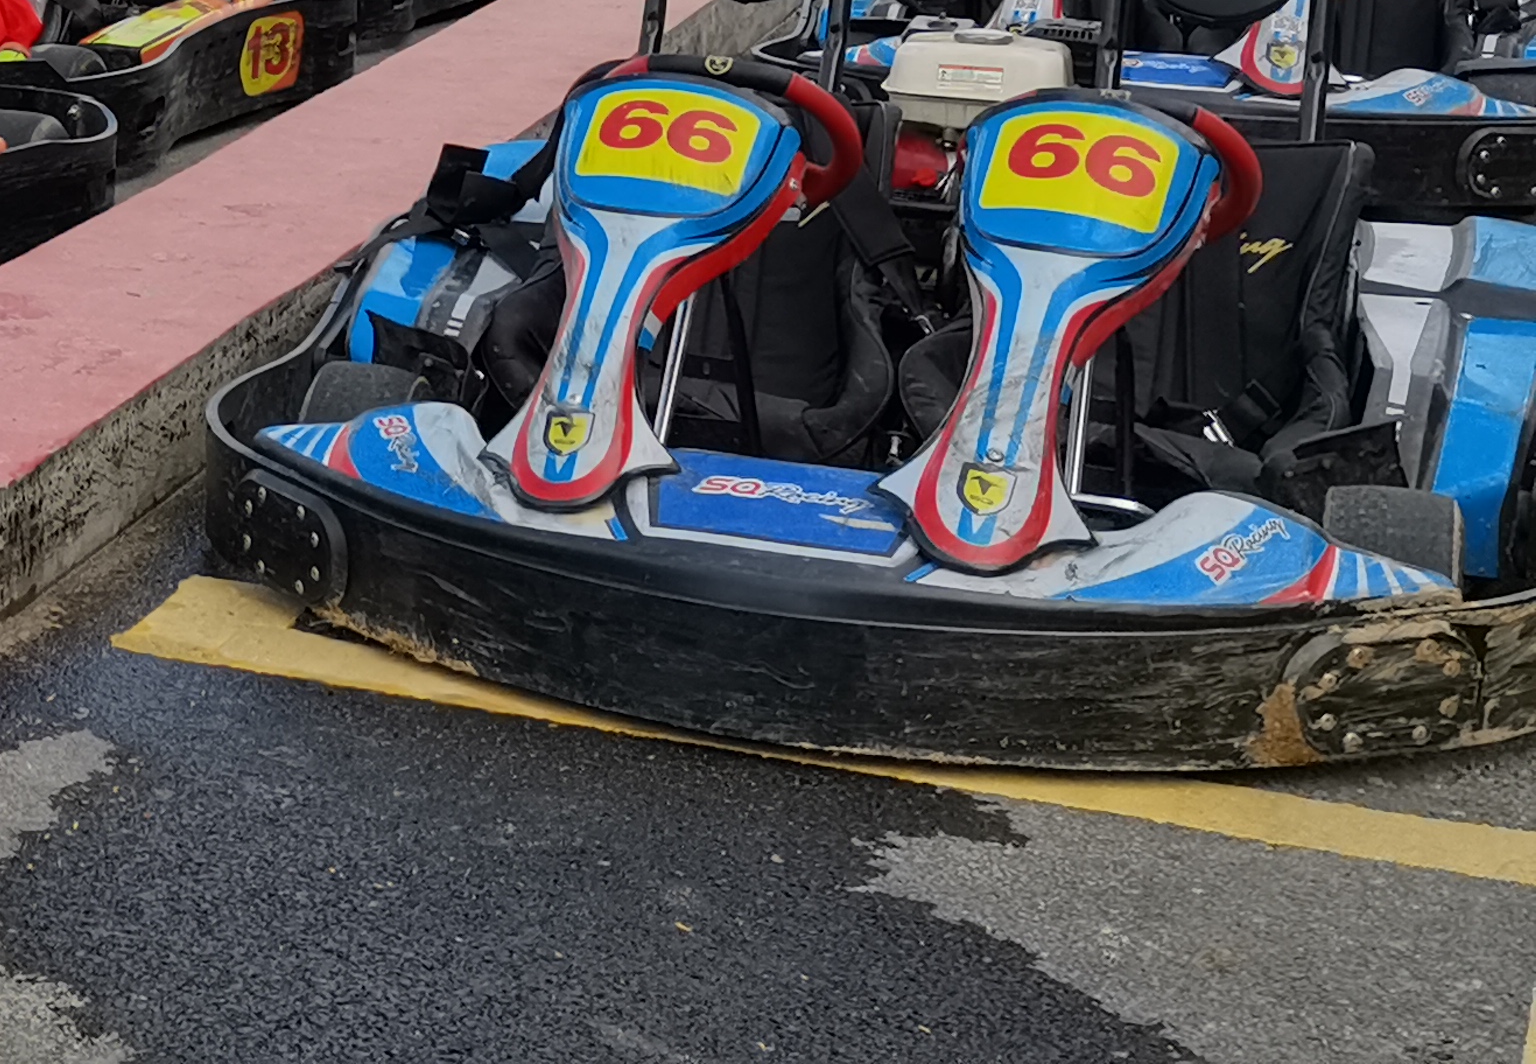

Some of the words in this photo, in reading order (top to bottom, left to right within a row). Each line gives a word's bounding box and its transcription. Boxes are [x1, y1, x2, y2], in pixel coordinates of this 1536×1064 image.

[247, 21, 291, 79] 13
[599, 100, 738, 163] 66
[1008, 124, 1162, 197] 66
